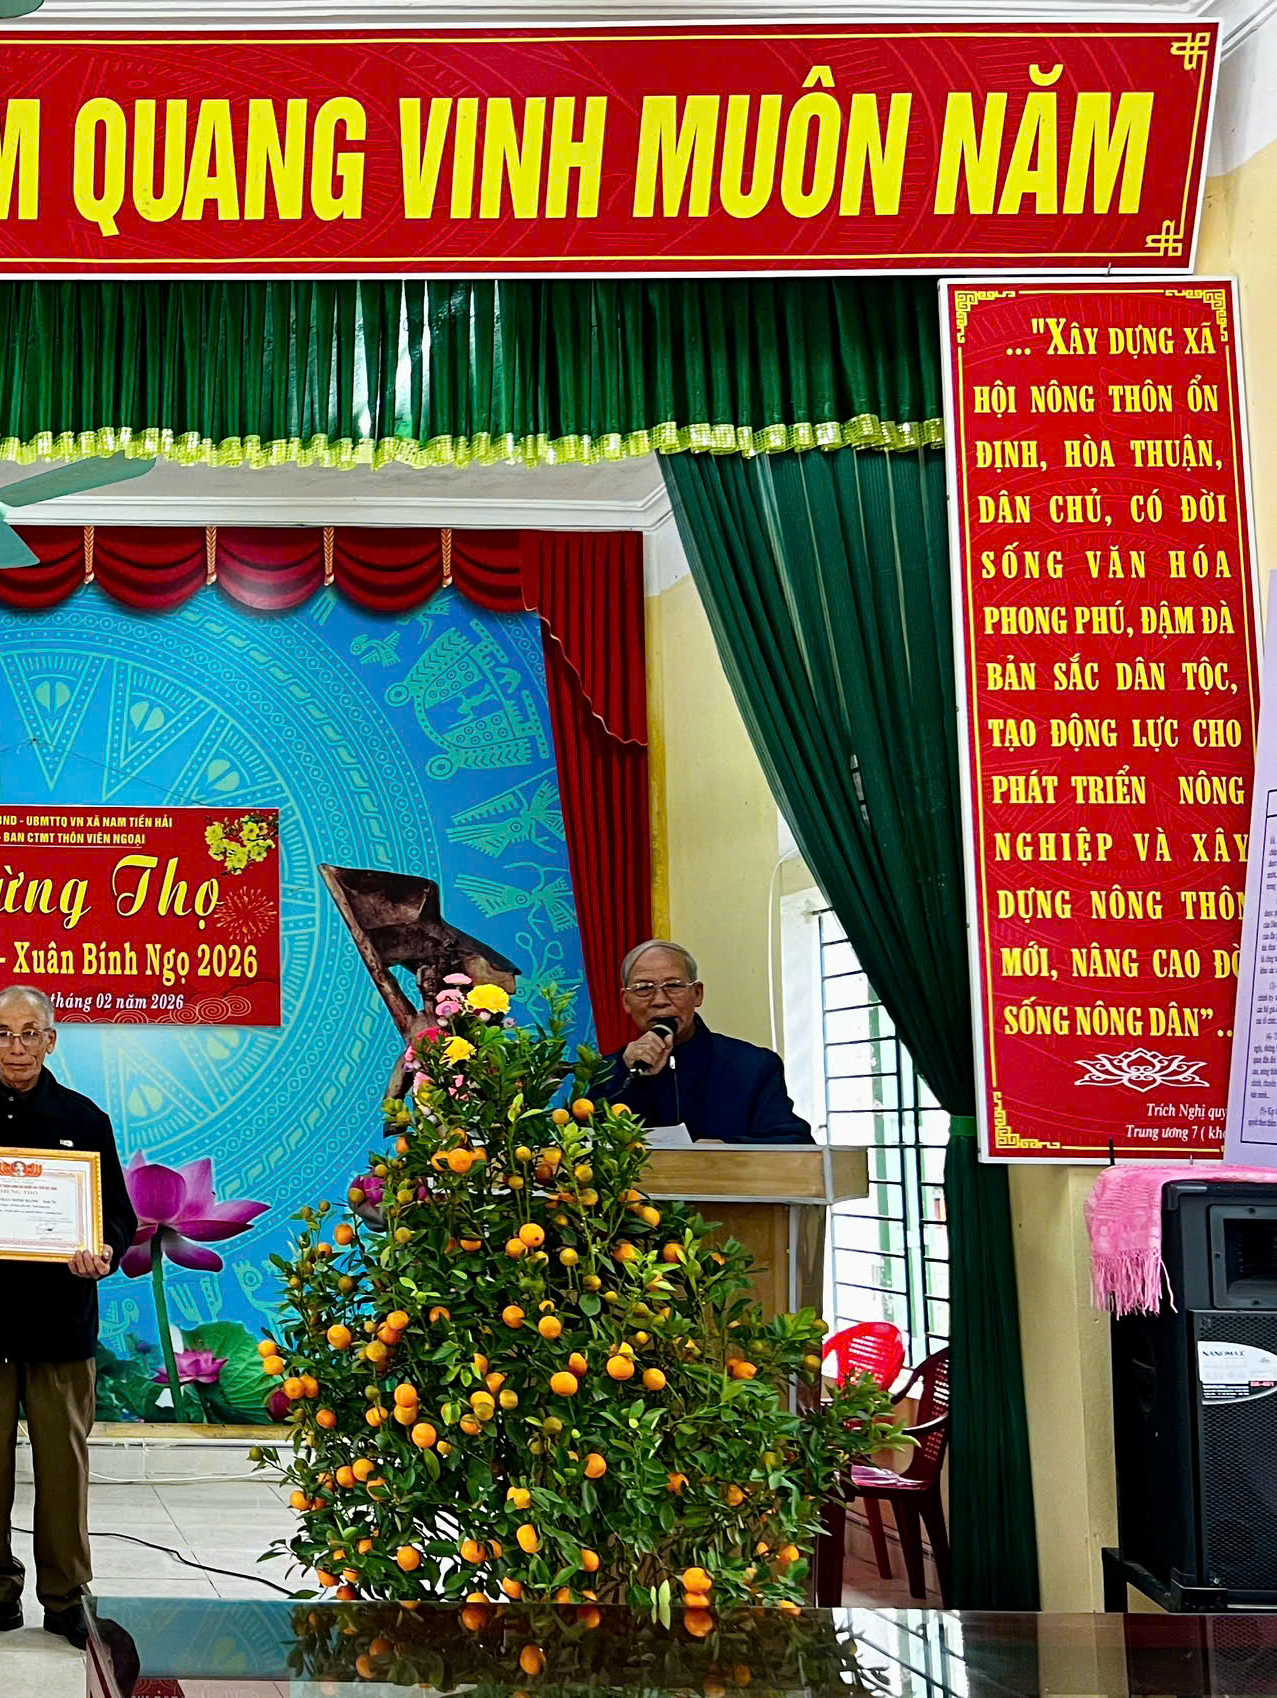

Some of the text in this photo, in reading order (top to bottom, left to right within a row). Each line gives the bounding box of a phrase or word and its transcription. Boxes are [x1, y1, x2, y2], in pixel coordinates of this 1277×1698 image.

[73, 97, 366, 237] QUANG
[399, 96, 607, 218] VINH
[633, 66, 912, 218] MUÔN
[934, 64, 1154, 214] NĂM
[1108, 325, 1174, 359] DỰNG
[1184, 322, 1216, 354] XÃ
[973, 374, 1218, 418] HỘI NÔNG THÔN ỔN
[975, 434, 1222, 472] ĐỊNH, HÒA THUẬN,
[978, 488, 1227, 526] DÂN CHỦ, CÓ ĐỜI
[981, 542, 1231, 578] SỐNG VĂN HÓA
[983, 600, 1235, 639] PHONG PHÚ, ĐẬM ĐÀ
[986, 653, 1237, 695] BẢN SẮC DÂN TỘC,
[988, 713, 1241, 752] TẠO ĐỘNG LỰC CHO
[991, 765, 1244, 804] PHÁT TRIỂN NÔNG
[3, 832, 25, 843] BAN
[27, 833, 54, 843] CTMT
[113, 834, 145, 846] NGOẠI
[26, 816, 68, 828] UBMTTQ
[70, 817, 84, 827] VN
[102, 817, 126, 828] NAM
[994, 827, 1247, 866] NGHIỆP VÀ XÂY
[112, 854, 225, 930] Thọ
[997, 884, 1163, 923] DỰNG NÔNG
[13, 941, 74, 975] Xuân
[82, 941, 138, 975] Bính
[145, 943, 190, 987] Ngọ
[197, 943, 258, 978] 2026
[1000, 941, 1200, 980] MỚI, NÂNG CAO
[96, 994, 113, 1009] 02
[116, 993, 148, 1009] năm
[151, 994, 184, 1009] 2026
[1004, 997, 1070, 1035] SỐNG
[1075, 1000, 1143, 1036] NÔNG
[1146, 1103, 1205, 1120] Trích Nghị
[1126, 1124, 1198, 1141] Trung ương 7
